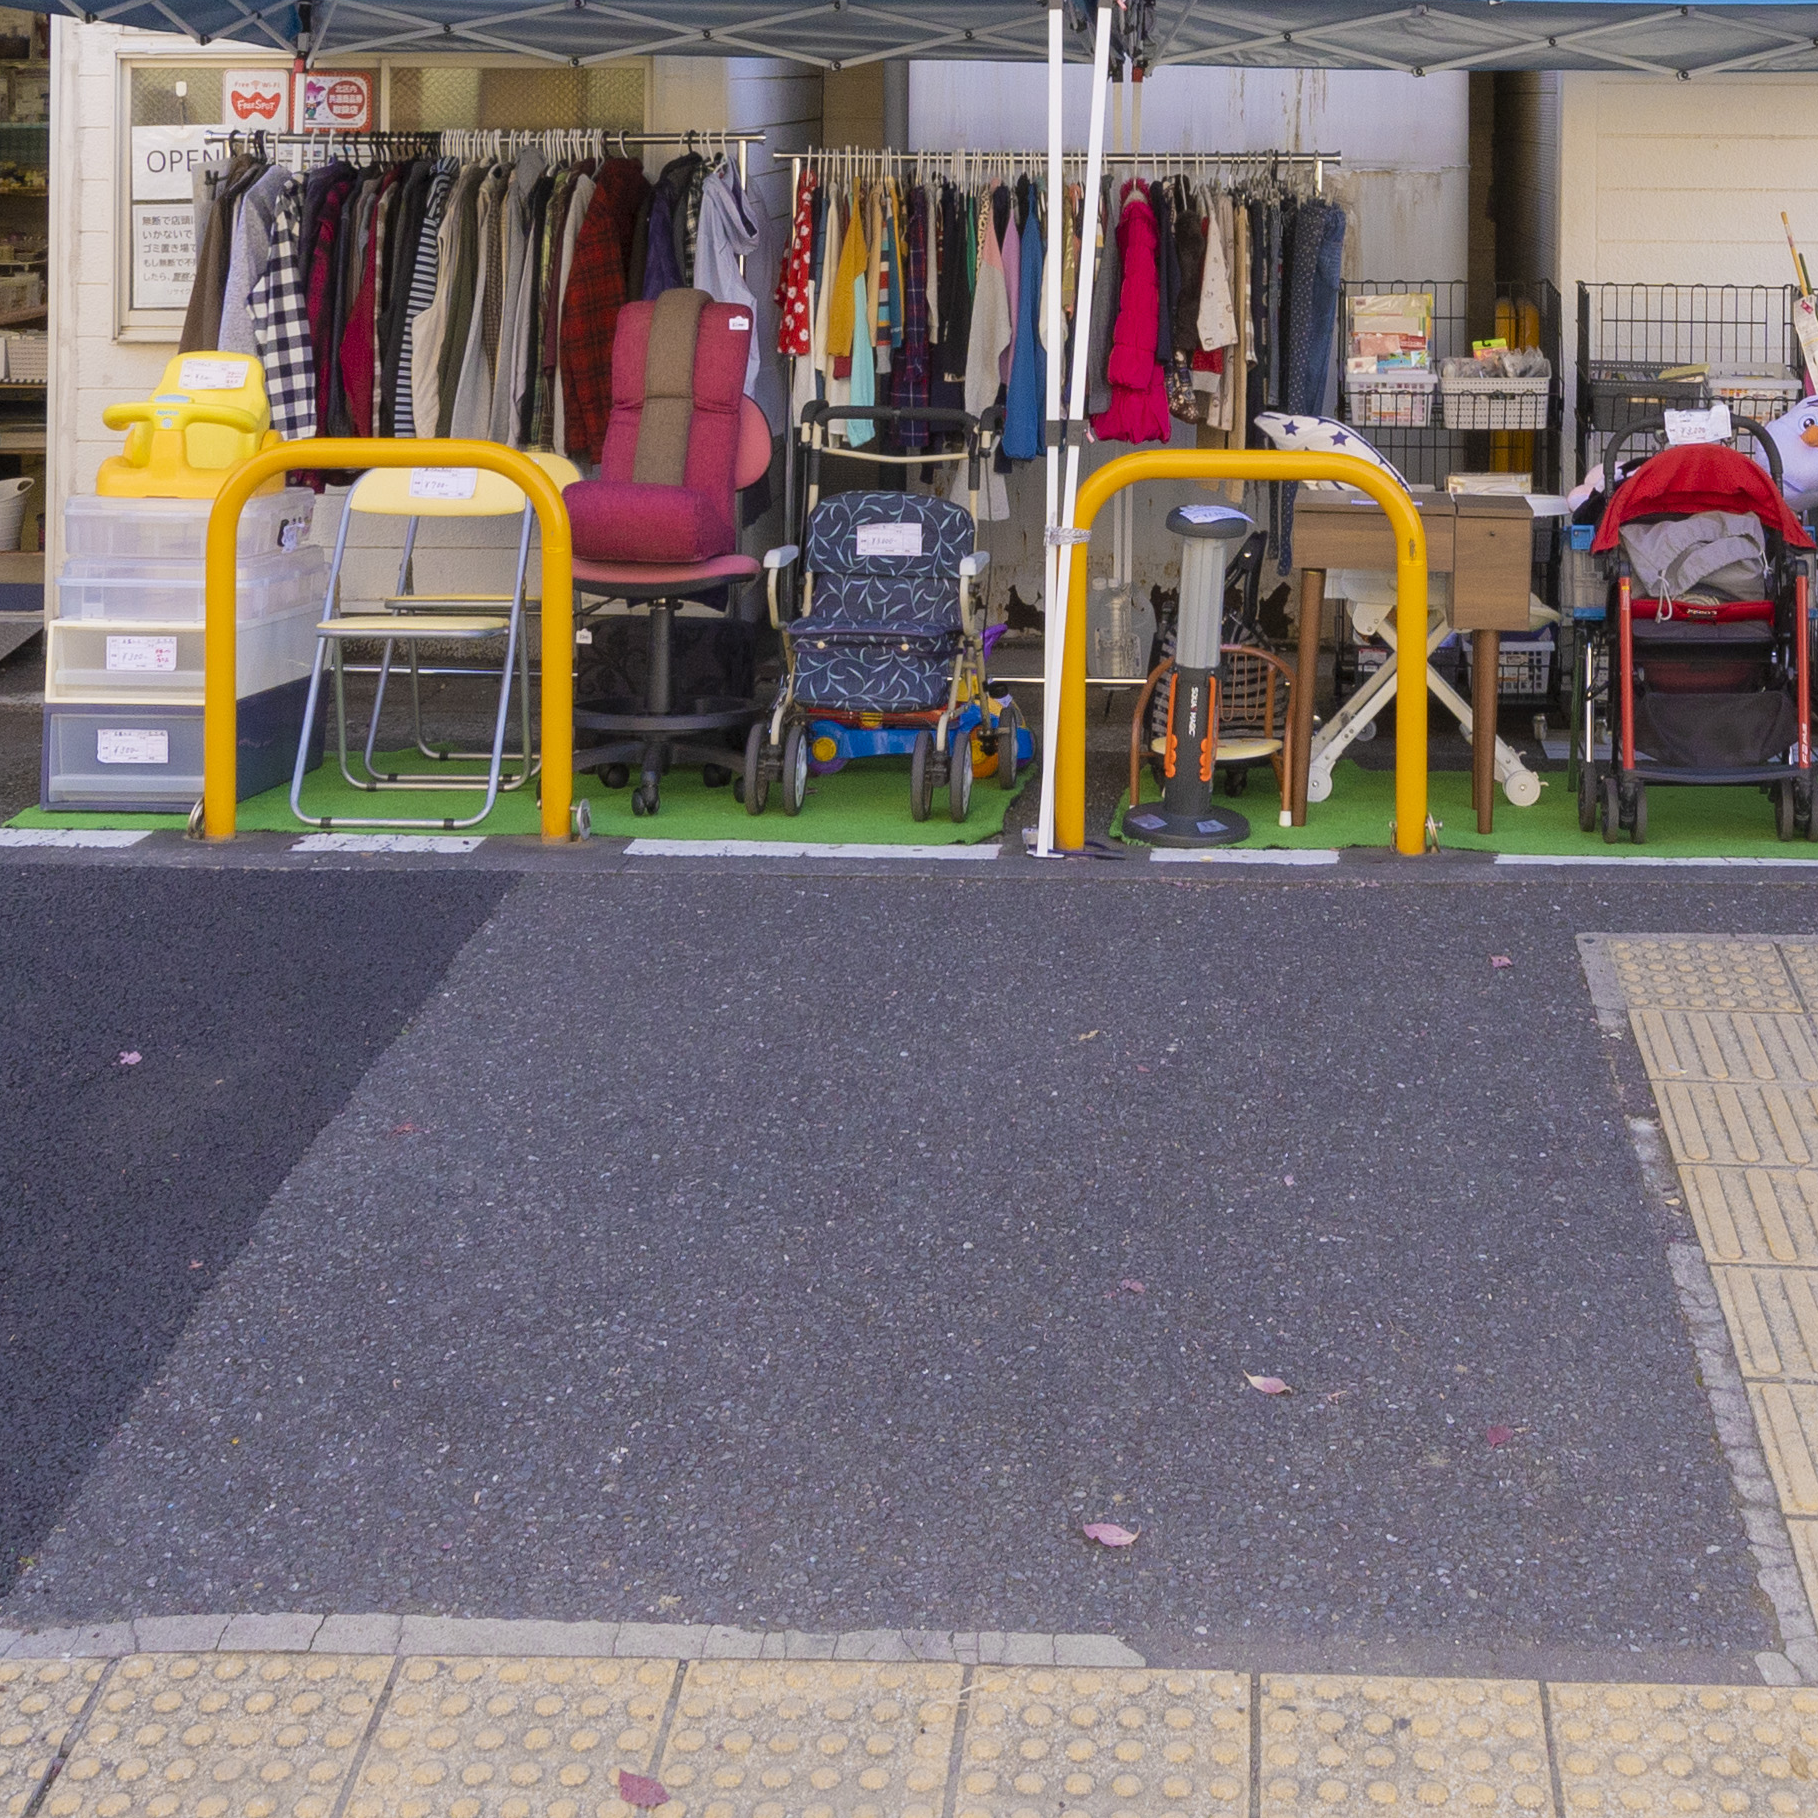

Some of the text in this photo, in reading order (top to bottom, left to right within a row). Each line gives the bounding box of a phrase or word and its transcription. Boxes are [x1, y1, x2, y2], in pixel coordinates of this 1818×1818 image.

[146, 148, 221, 173] OPEN
[142, 229, 193, 239] いかないで
